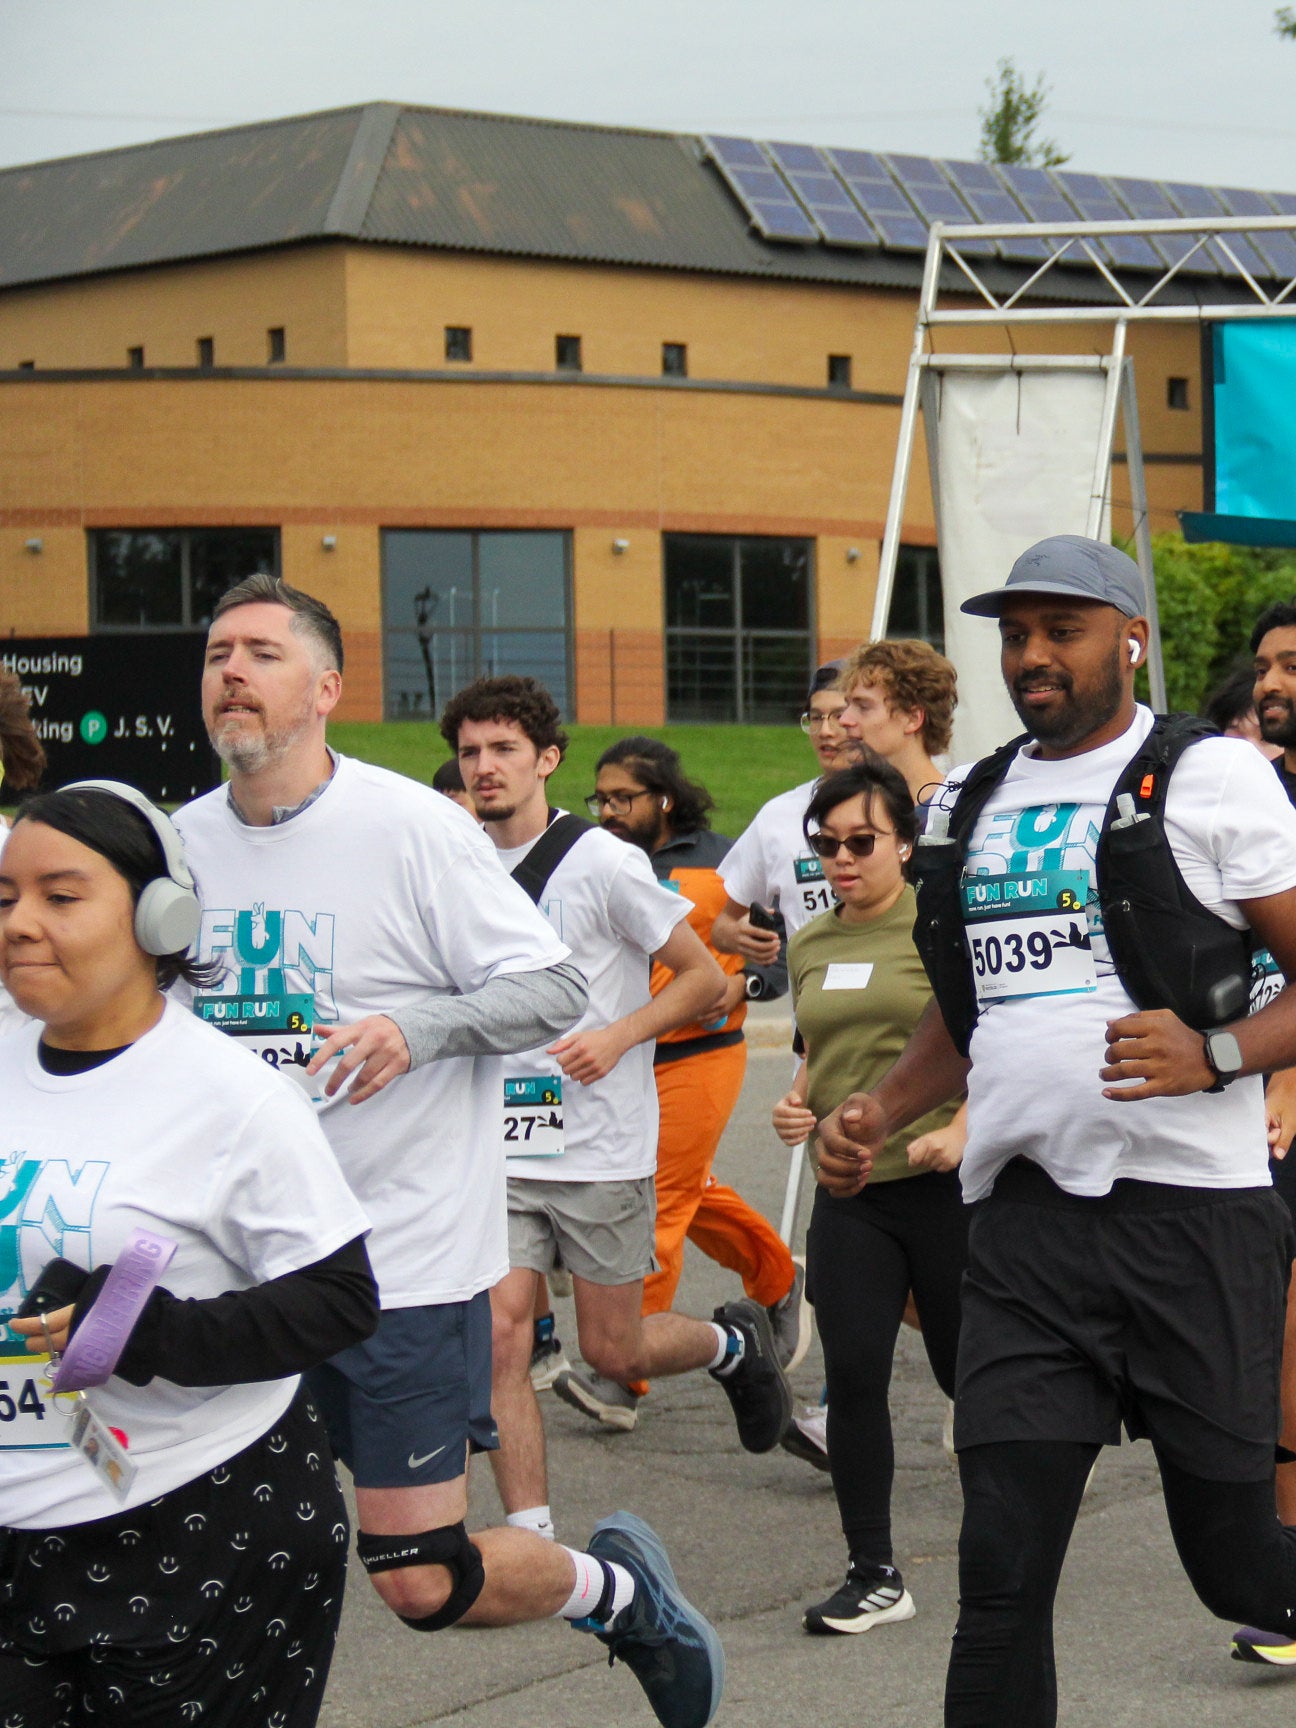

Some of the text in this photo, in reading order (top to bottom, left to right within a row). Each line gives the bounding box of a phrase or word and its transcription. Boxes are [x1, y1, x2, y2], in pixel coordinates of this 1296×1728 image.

[3, 651, 83, 676] Housing
[88, 719, 100, 738] P
[114, 716, 130, 738] J.
[135, 714, 153, 737] S.
[156, 714, 175, 736] V.
[967, 877, 1048, 905] FUN RUN
[1062, 892, 1072, 907] 5
[198, 904, 336, 972] FUN
[971, 930, 1053, 977] 5039
[203, 1000, 280, 1019] FUN RUN
[291, 1015, 299, 1029] 5
[505, 1081, 536, 1096] RUN
[545, 1091, 553, 1103] 5
[504, 1116, 536, 1142] 27
[72, 1237, 163, 1382] NGINEERING
[368, 1547, 419, 1563] MUELLER
